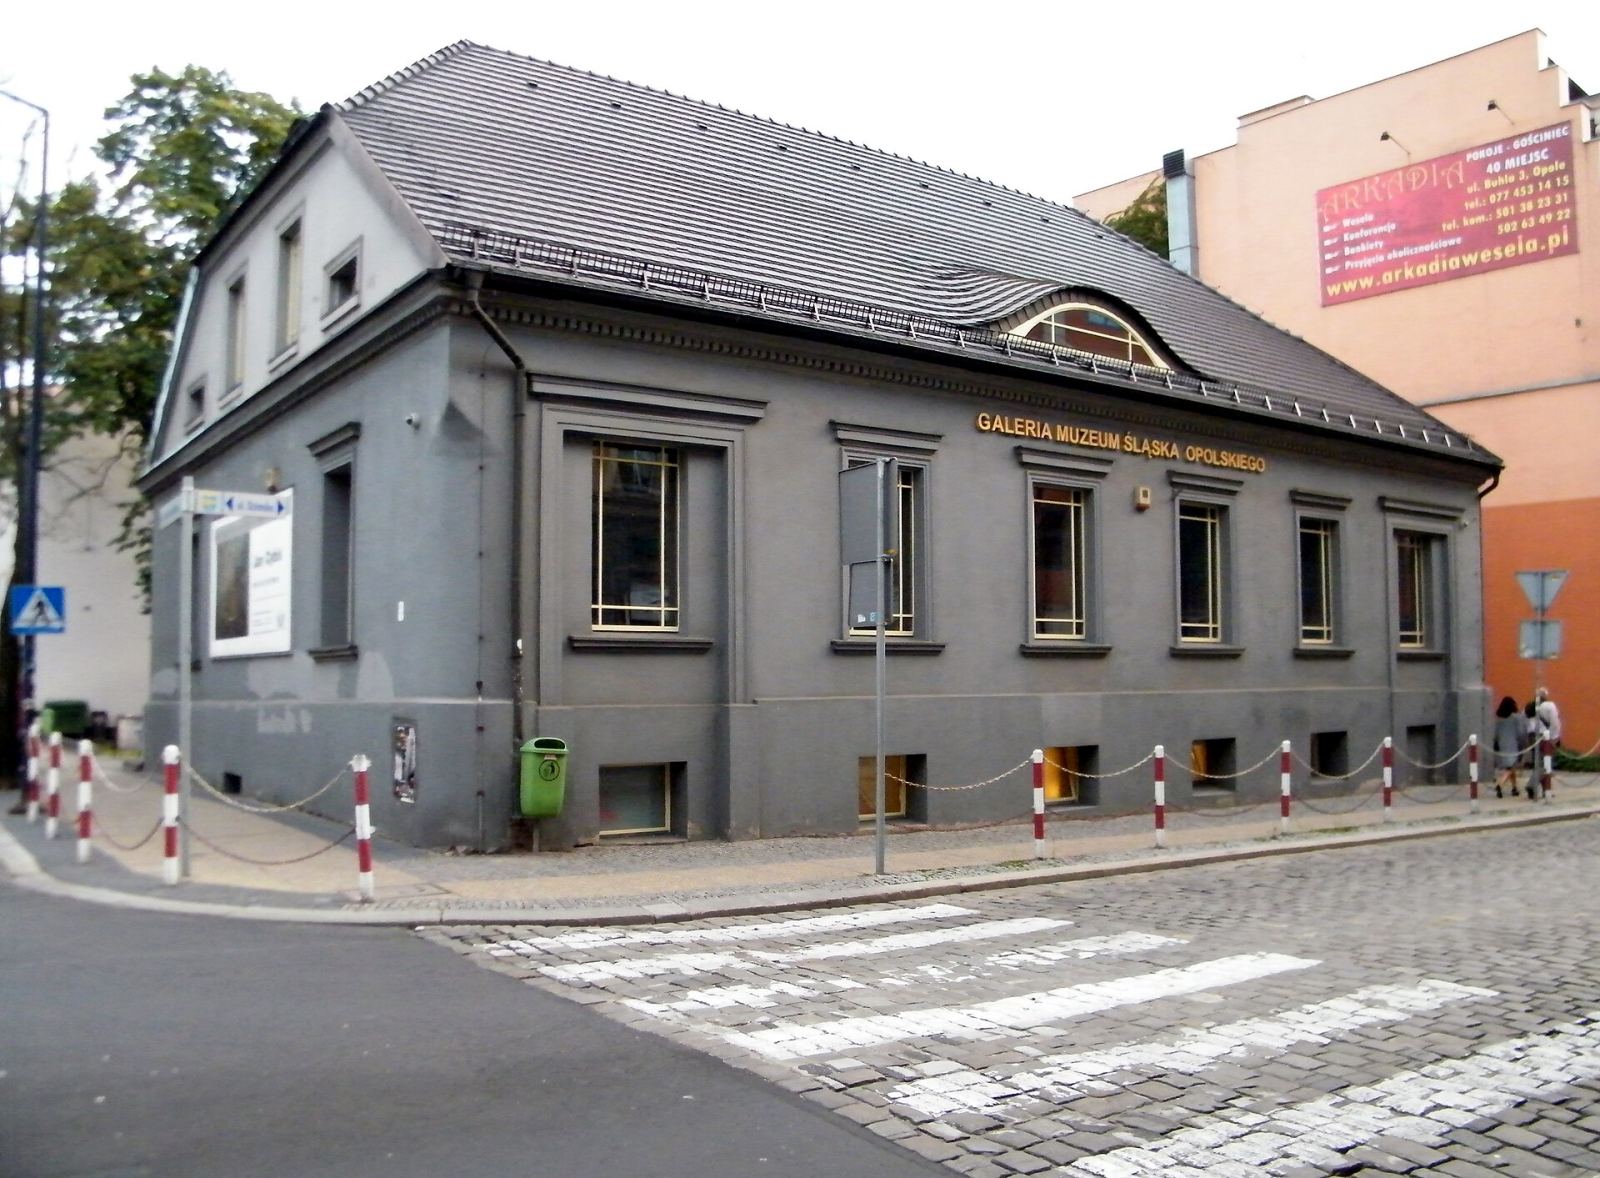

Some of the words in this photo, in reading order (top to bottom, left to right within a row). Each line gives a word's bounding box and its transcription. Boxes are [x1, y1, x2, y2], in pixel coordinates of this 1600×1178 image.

[1466, 144, 1504, 162] POKOJE
[1513, 126, 1569, 150] GOŚCINIEC
[1486, 163, 1501, 174] 40
[1505, 148, 1549, 170] MIEJSC
[1319, 160, 1465, 223] ARKADIA
[1467, 183, 1480, 194] ul.
[1533, 160, 1566, 177] Opole
[1489, 190, 1509, 204] 077
[1513, 184, 1534, 198] 453
[1539, 180, 1551, 192] 14
[1556, 175, 1570, 187] 15
[1496, 206, 1515, 219] 501
[1520, 201, 1534, 213] 38
[1538, 196, 1551, 209] 23
[1556, 193, 1568, 202] 31
[1498, 221, 1518, 235] 502
[1521, 216, 1536, 229] 63
[1539, 213, 1552, 224] 49
[1557, 208, 1570, 221] 22
[1326, 224, 1569, 296] www.arkadiawesela.pl
[977, 412, 1052, 440] GALERIA
[1056, 425, 1120, 450] MUZEUM
[1124, 431, 1180, 459] ŚLĄSKA
[1185, 446, 1266, 473] OPOLSKIEGO
